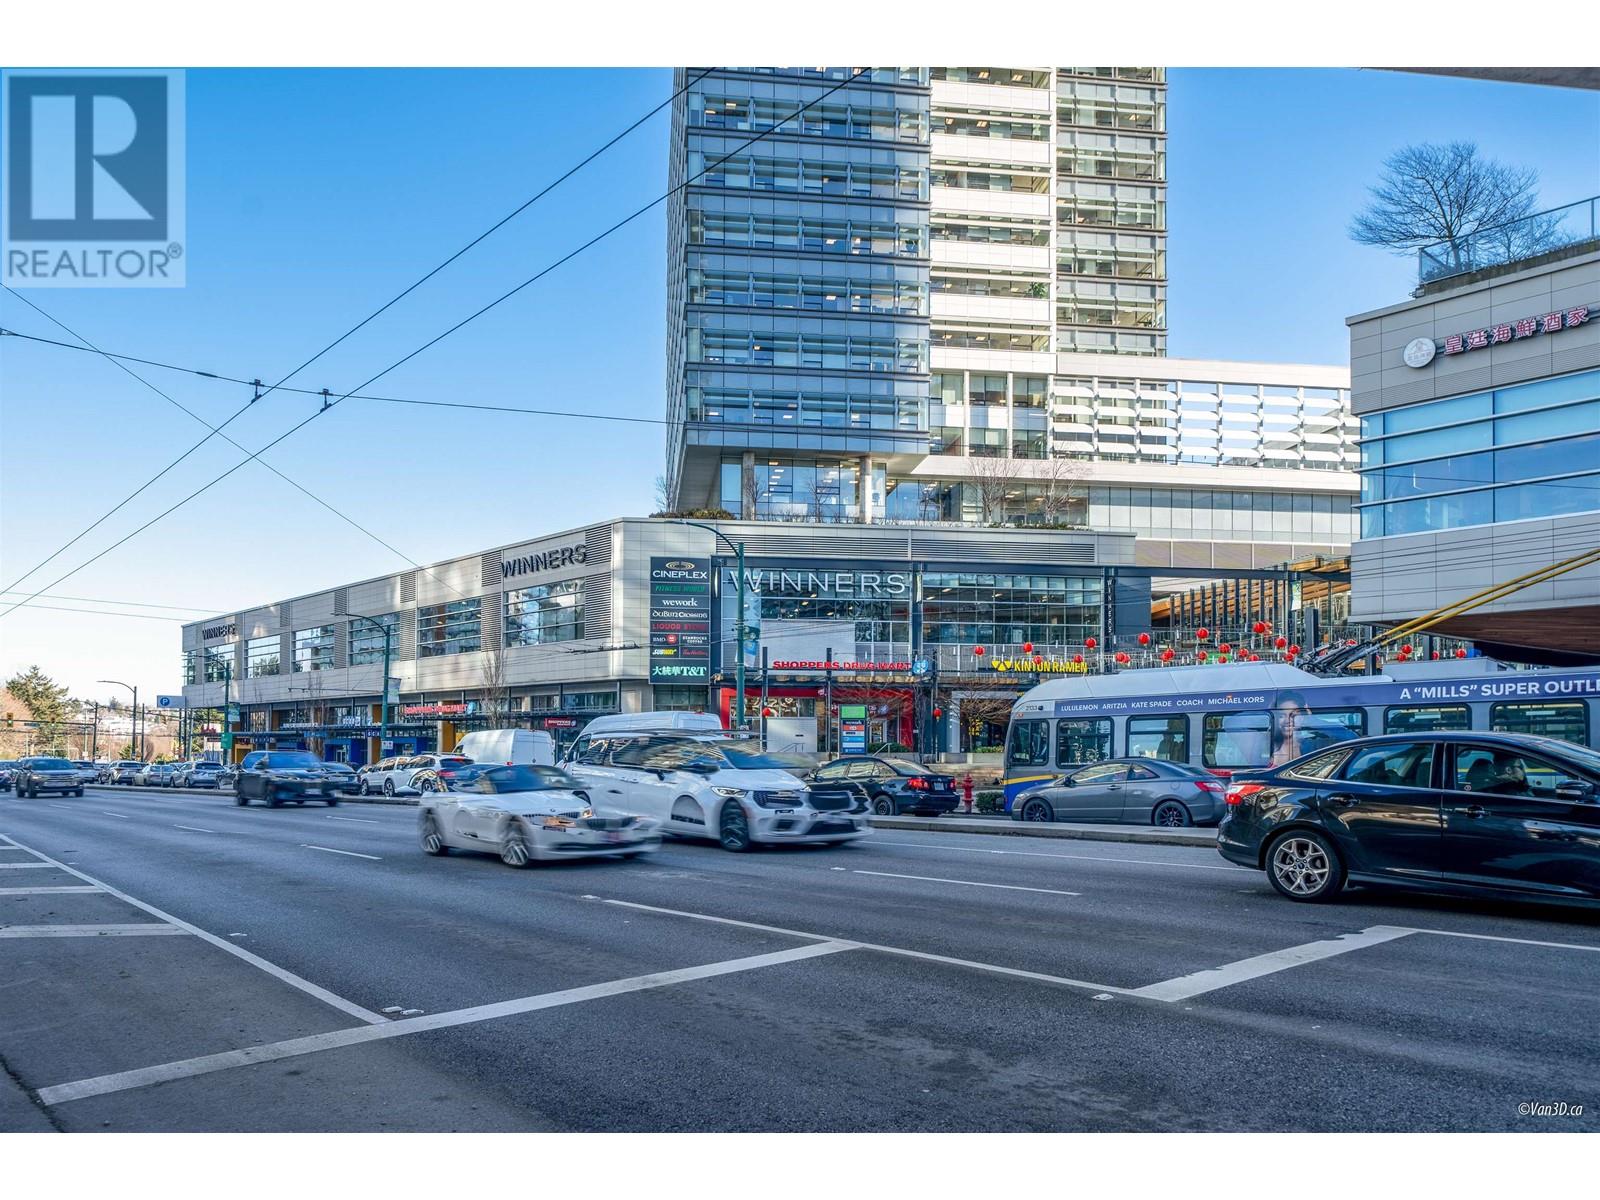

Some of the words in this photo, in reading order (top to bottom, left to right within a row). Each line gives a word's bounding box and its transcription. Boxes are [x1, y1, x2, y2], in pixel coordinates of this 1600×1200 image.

[501, 543, 587, 578] WINNERS
[652, 570, 708, 579] CINEPLEX
[729, 570, 906, 594] WINNERS
[662, 597, 698, 607] wework
[773, 660, 839, 670] SHOPPERS
[1052, 660, 1088, 673] RAMEN
[681, 666, 707, 677] T&T
[1400, 688, 1412, 699] A
[1481, 682, 1540, 696] SUPER
